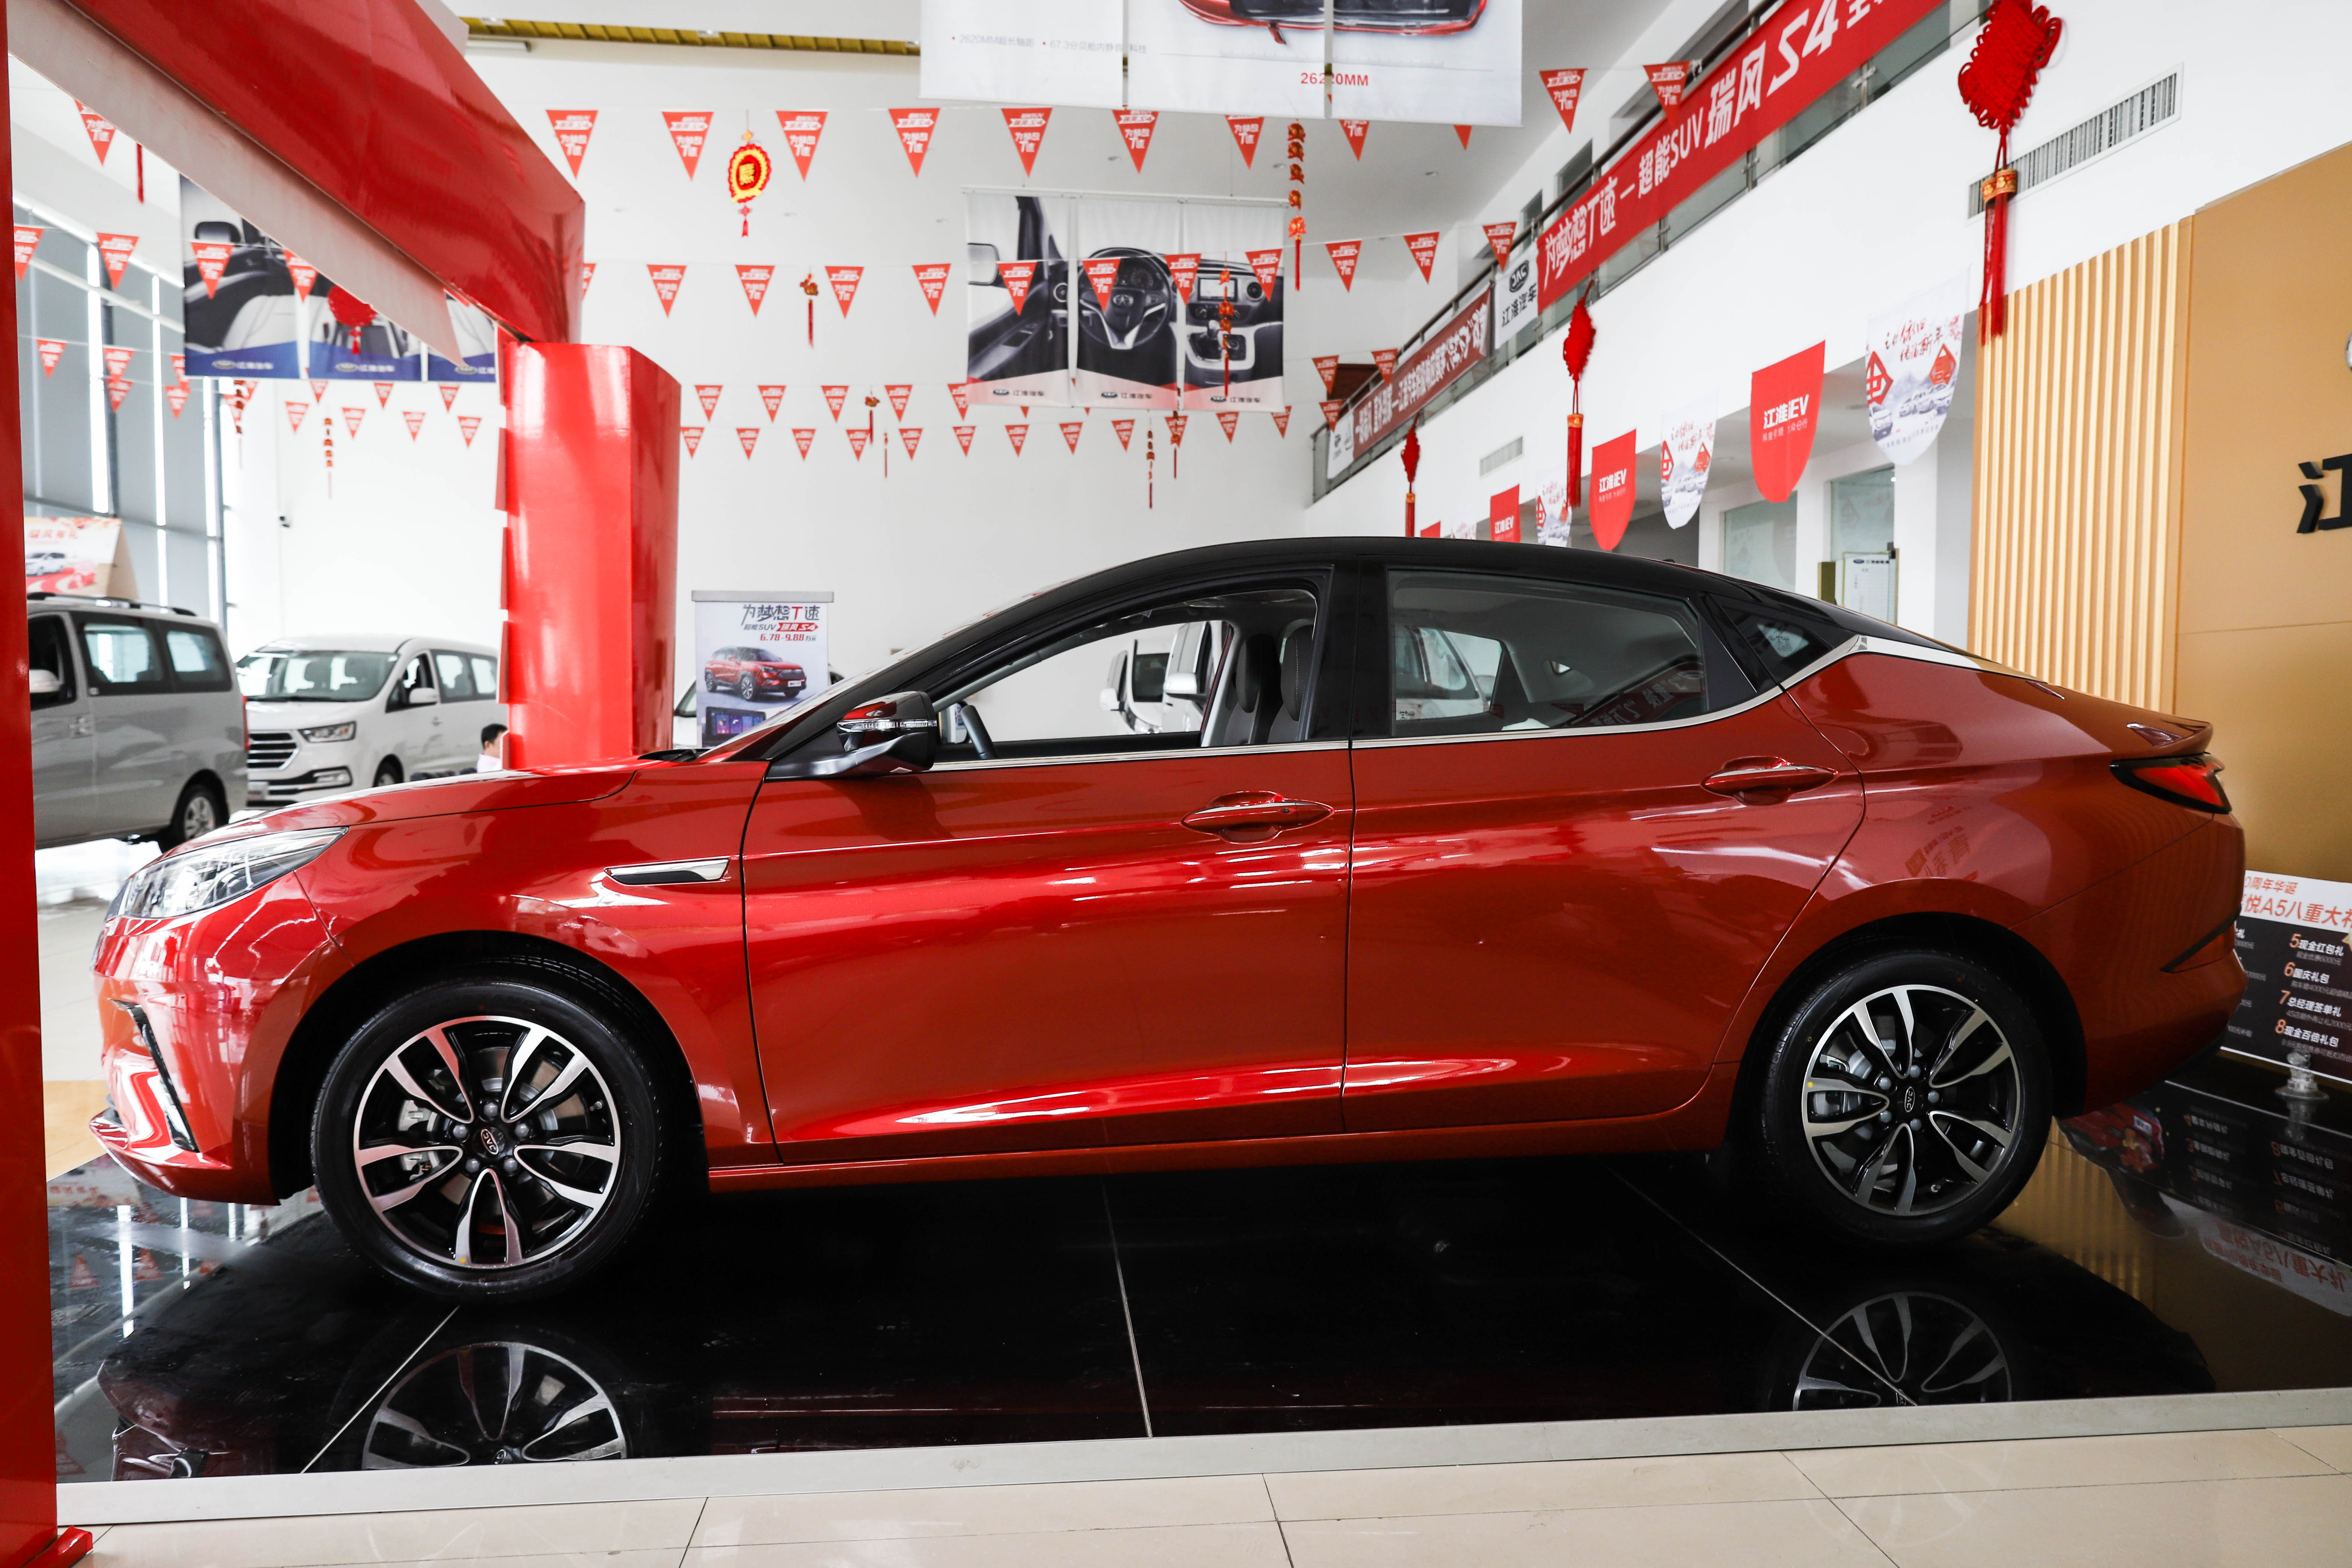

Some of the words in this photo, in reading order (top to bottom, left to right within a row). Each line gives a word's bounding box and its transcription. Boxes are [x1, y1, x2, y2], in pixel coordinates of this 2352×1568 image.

[1544, 176, 1618, 292] 为梦想T速
[1502, 283, 1537, 327] 江淮汽车
[1763, 394, 1809, 429] 江淮iEV
[741, 604, 821, 626] 为梦想T速
[2242, 893, 2352, 928] 悦A5八重大
[2292, 968, 2330, 984] 国庆礼包
[483, 1132, 496, 1150] JAC
